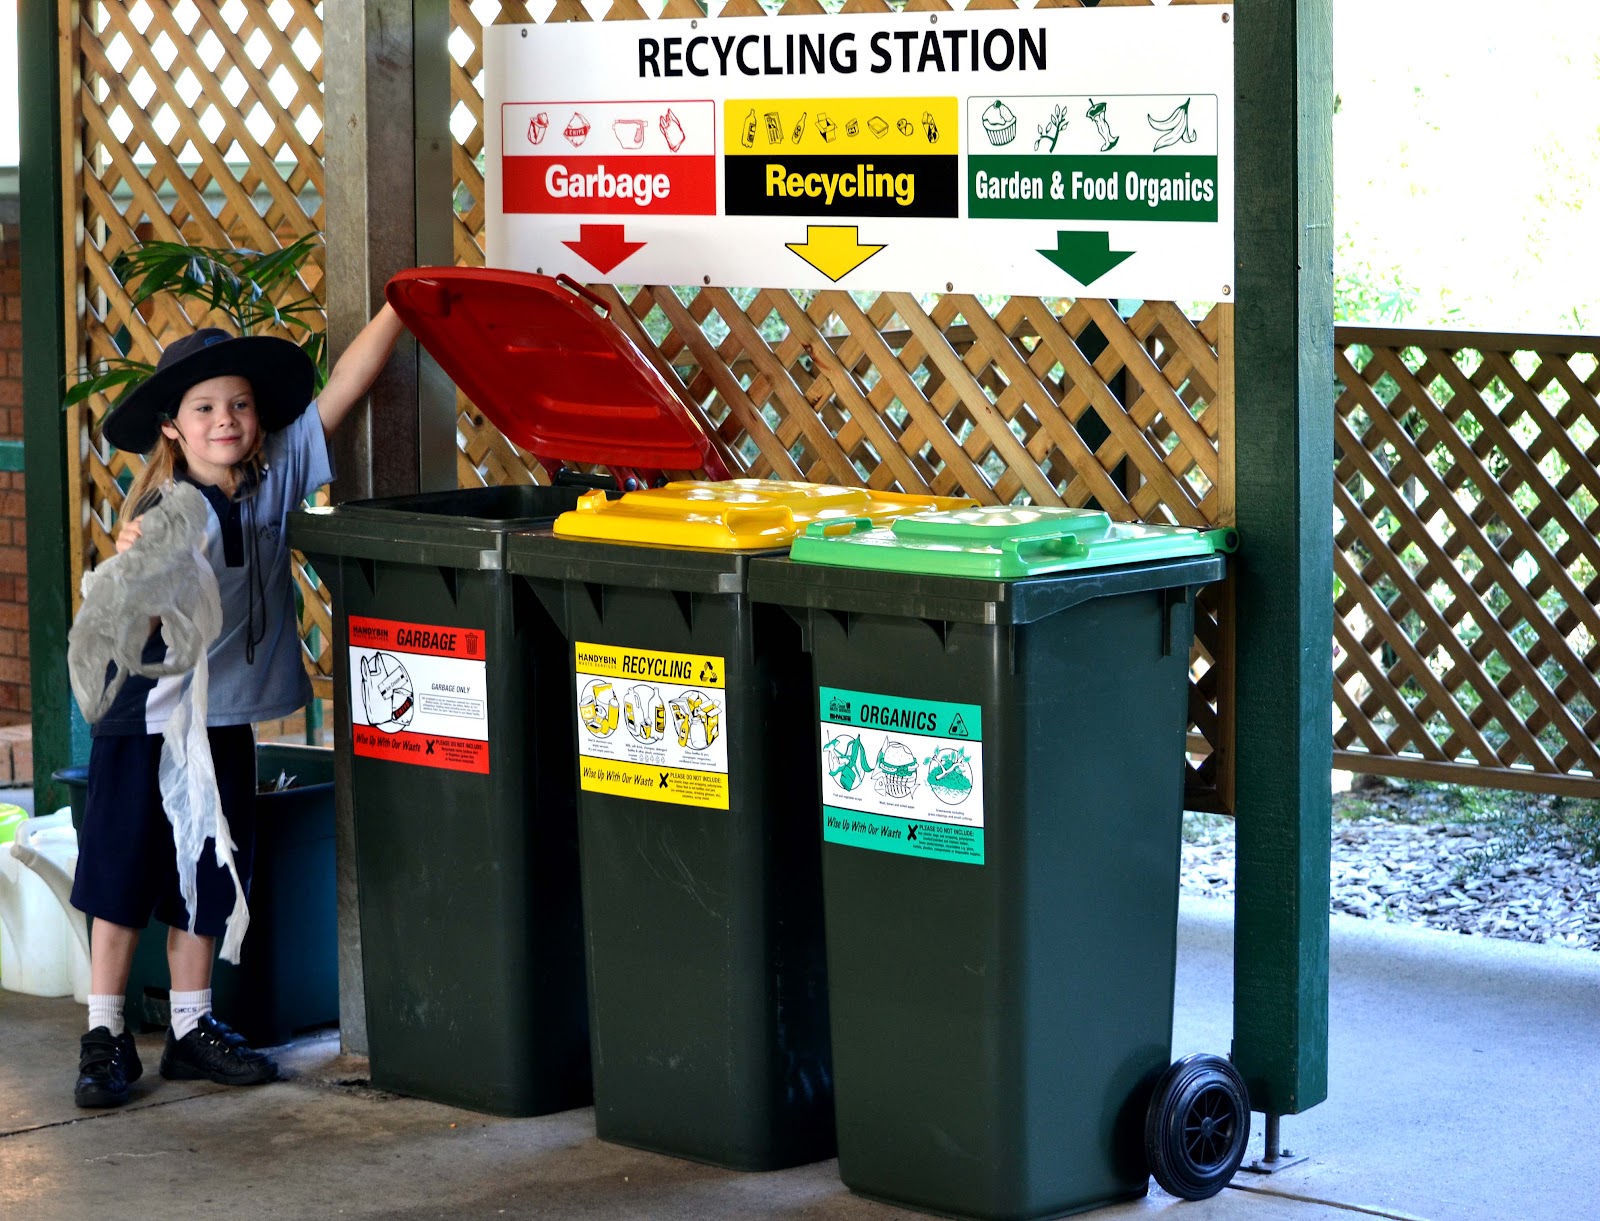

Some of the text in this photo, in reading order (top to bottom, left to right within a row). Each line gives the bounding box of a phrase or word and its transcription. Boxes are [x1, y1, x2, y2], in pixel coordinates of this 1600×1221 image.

[638, 26, 1047, 78] RECYCLING STATION
[544, 164, 671, 207] Garbage
[765, 163, 916, 207] Recycling
[975, 170, 1215, 207] Garden & Food Organics
[353, 625, 389, 637] HANDYBIN
[396, 628, 457, 652] GARBAGE
[578, 653, 617, 665] HANDYBIN
[622, 655, 693, 680] RECYCLING
[431, 682, 471, 694] GARBAGE ONLY
[859, 704, 938, 732] ORGANICS
[356, 733, 421, 753] Wise Up With Our Waste
[435, 739, 451, 747] PLEASE
[457, 741, 465, 749] NOT
[583, 767, 597, 779] Wise
[597, 769, 605, 782] Up
[606, 770, 621, 782] With
[622, 772, 632, 784] Our
[634, 774, 654, 787] Waste
[669, 772, 686, 780] PLEASE
[827, 815, 841, 829] Wise
[842, 819, 850, 832] Up
[851, 820, 867, 834] With
[867, 823, 879, 835] Our
[880, 825, 902, 839] Waste
[919, 824, 936, 833] PLEASE
[936, 826, 944, 834] DO
[943, 827, 953, 835] NOT
